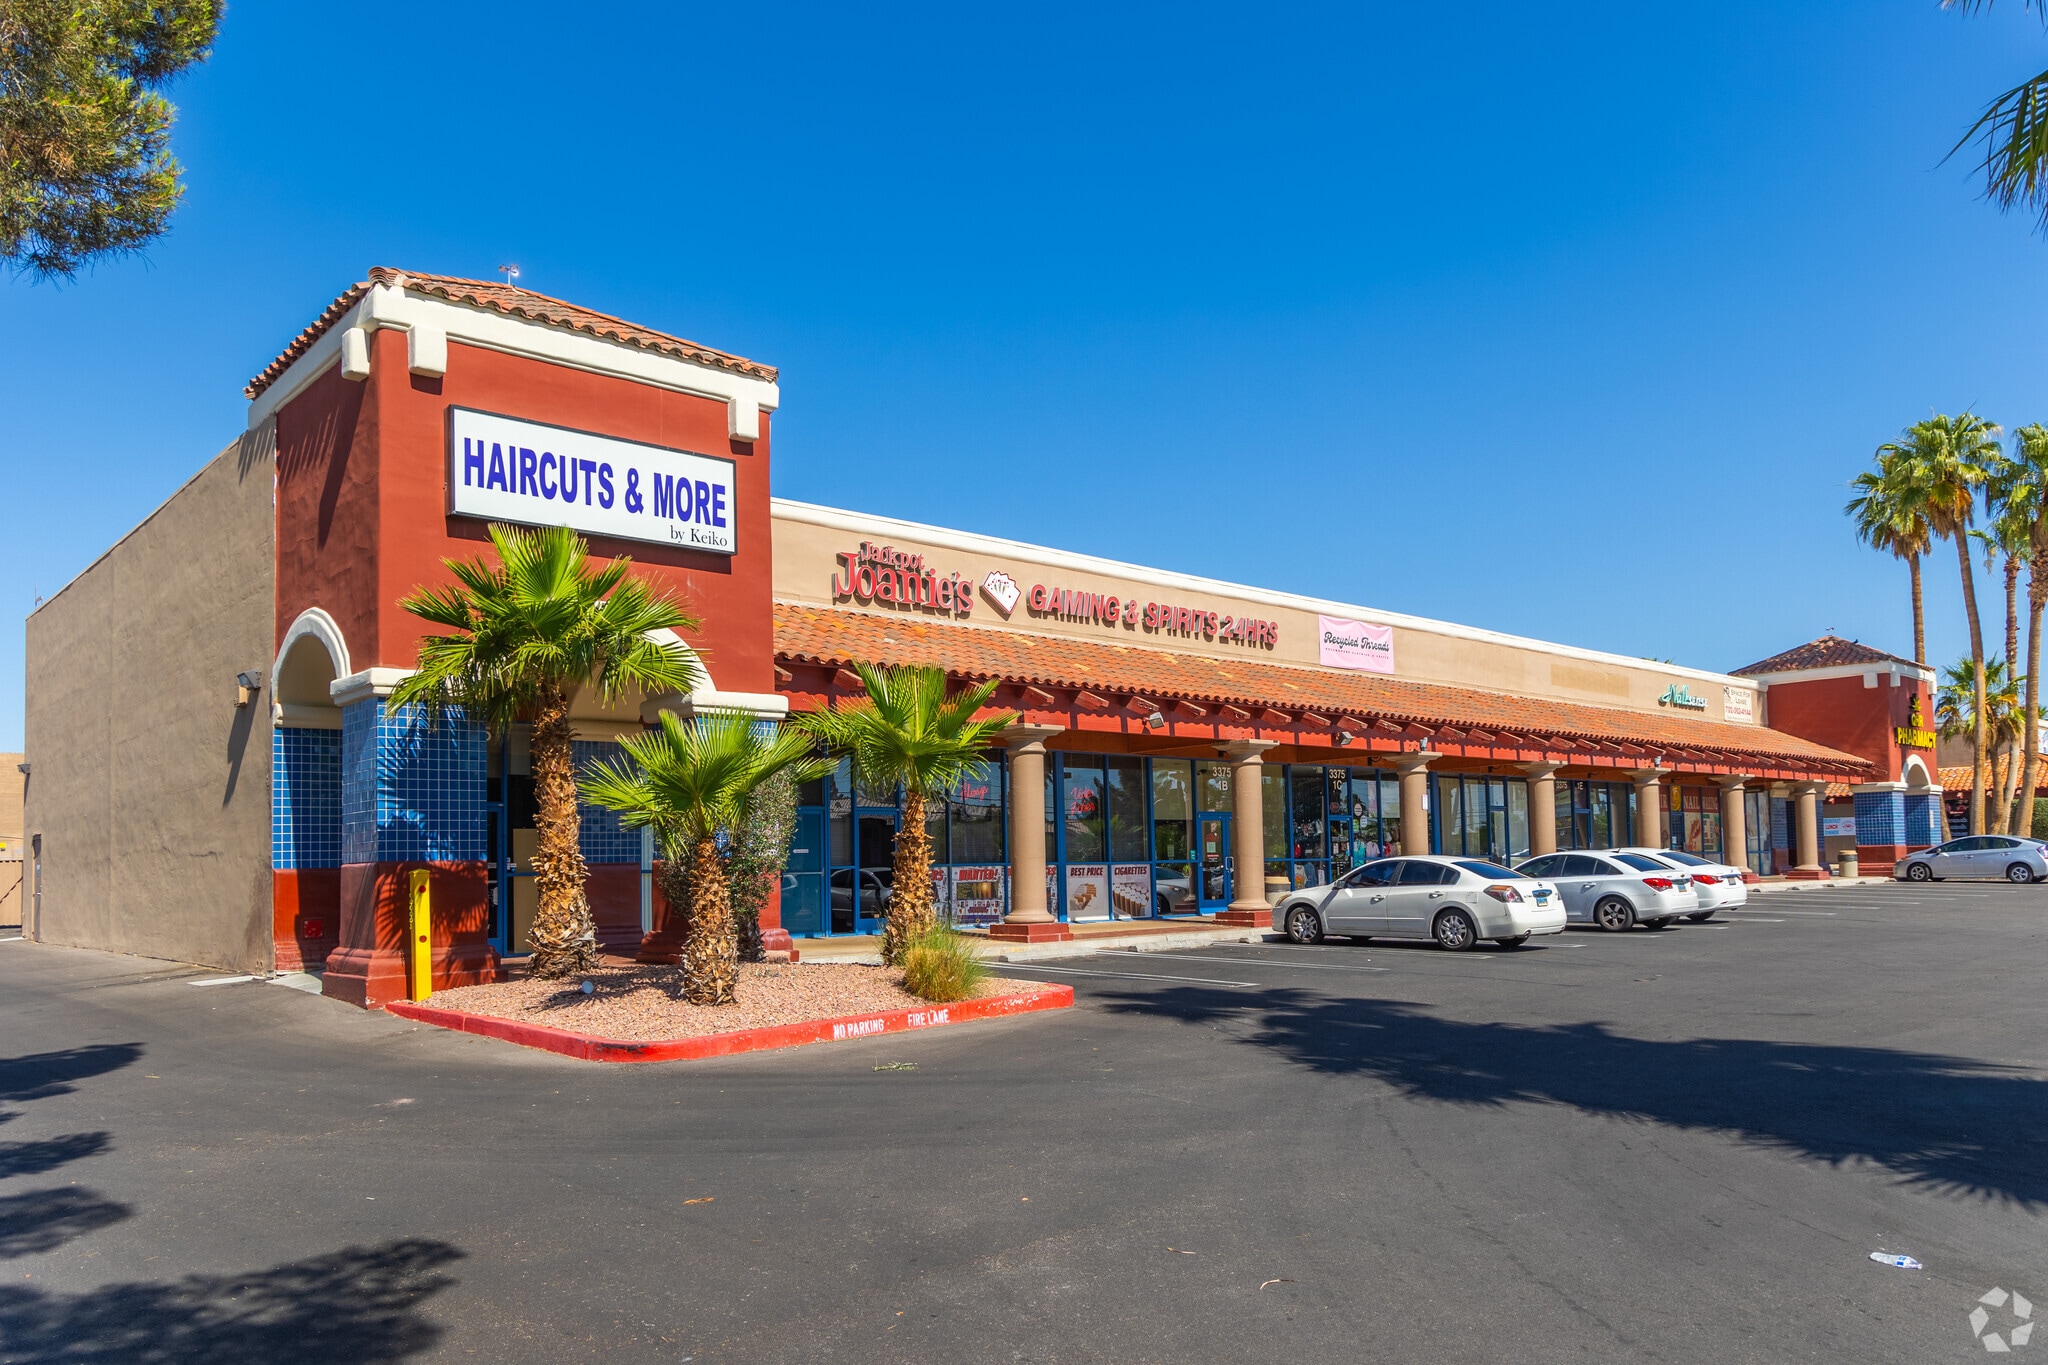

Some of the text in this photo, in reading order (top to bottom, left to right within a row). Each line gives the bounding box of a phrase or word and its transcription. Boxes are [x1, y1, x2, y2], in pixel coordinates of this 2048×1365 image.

[463, 437, 727, 528] HAIRCUTS & MORE
[670, 524, 728, 547] by Keiko
[860, 541, 925, 570] Jackpot
[834, 551, 974, 614] Joanie's
[1028, 583, 1278, 645] GAMING & SPIRITS 24HRS
[1323, 631, 1390, 653] Recycled Threads
[1897, 726, 1937, 749] PHARMACY
[1212, 766, 1232, 778] 3375
[1328, 768, 1346, 779] 3375
[1217, 780, 1229, 791] 1B
[1332, 779, 1343, 790] 1C
[1576, 781, 1584, 790] 1E
[1683, 795, 1700, 810] NAIL
[958, 868, 999, 881] WANTED!
[1070, 867, 1104, 877] BEST PRICE
[1114, 866, 1148, 876] CIGARETTES
[833, 1009, 949, 1039] NO PARKING FIRE LANE
